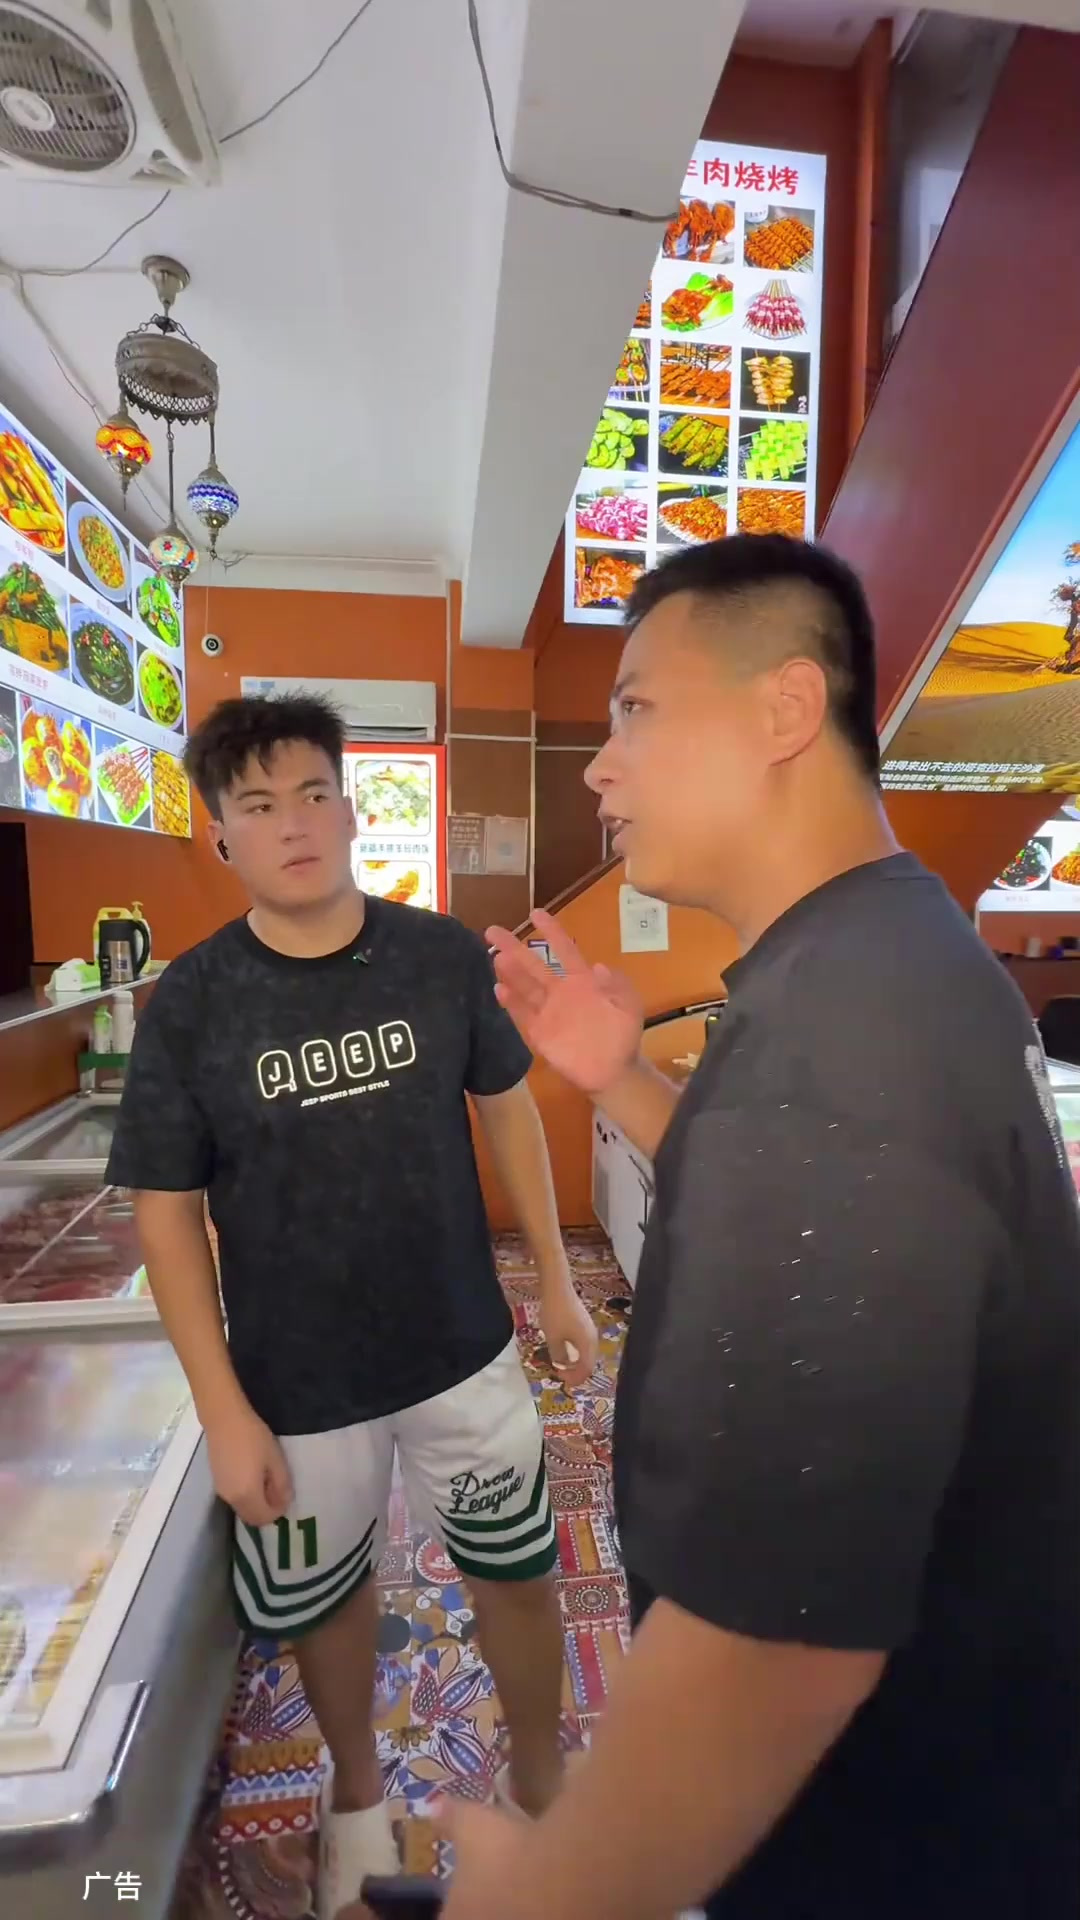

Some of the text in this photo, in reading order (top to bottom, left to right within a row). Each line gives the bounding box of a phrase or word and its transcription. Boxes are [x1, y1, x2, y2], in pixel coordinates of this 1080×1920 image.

[257, 1020, 416, 1099] JEEP
[448, 1472, 526, 1514] League
[274, 1515, 318, 1570] 11
